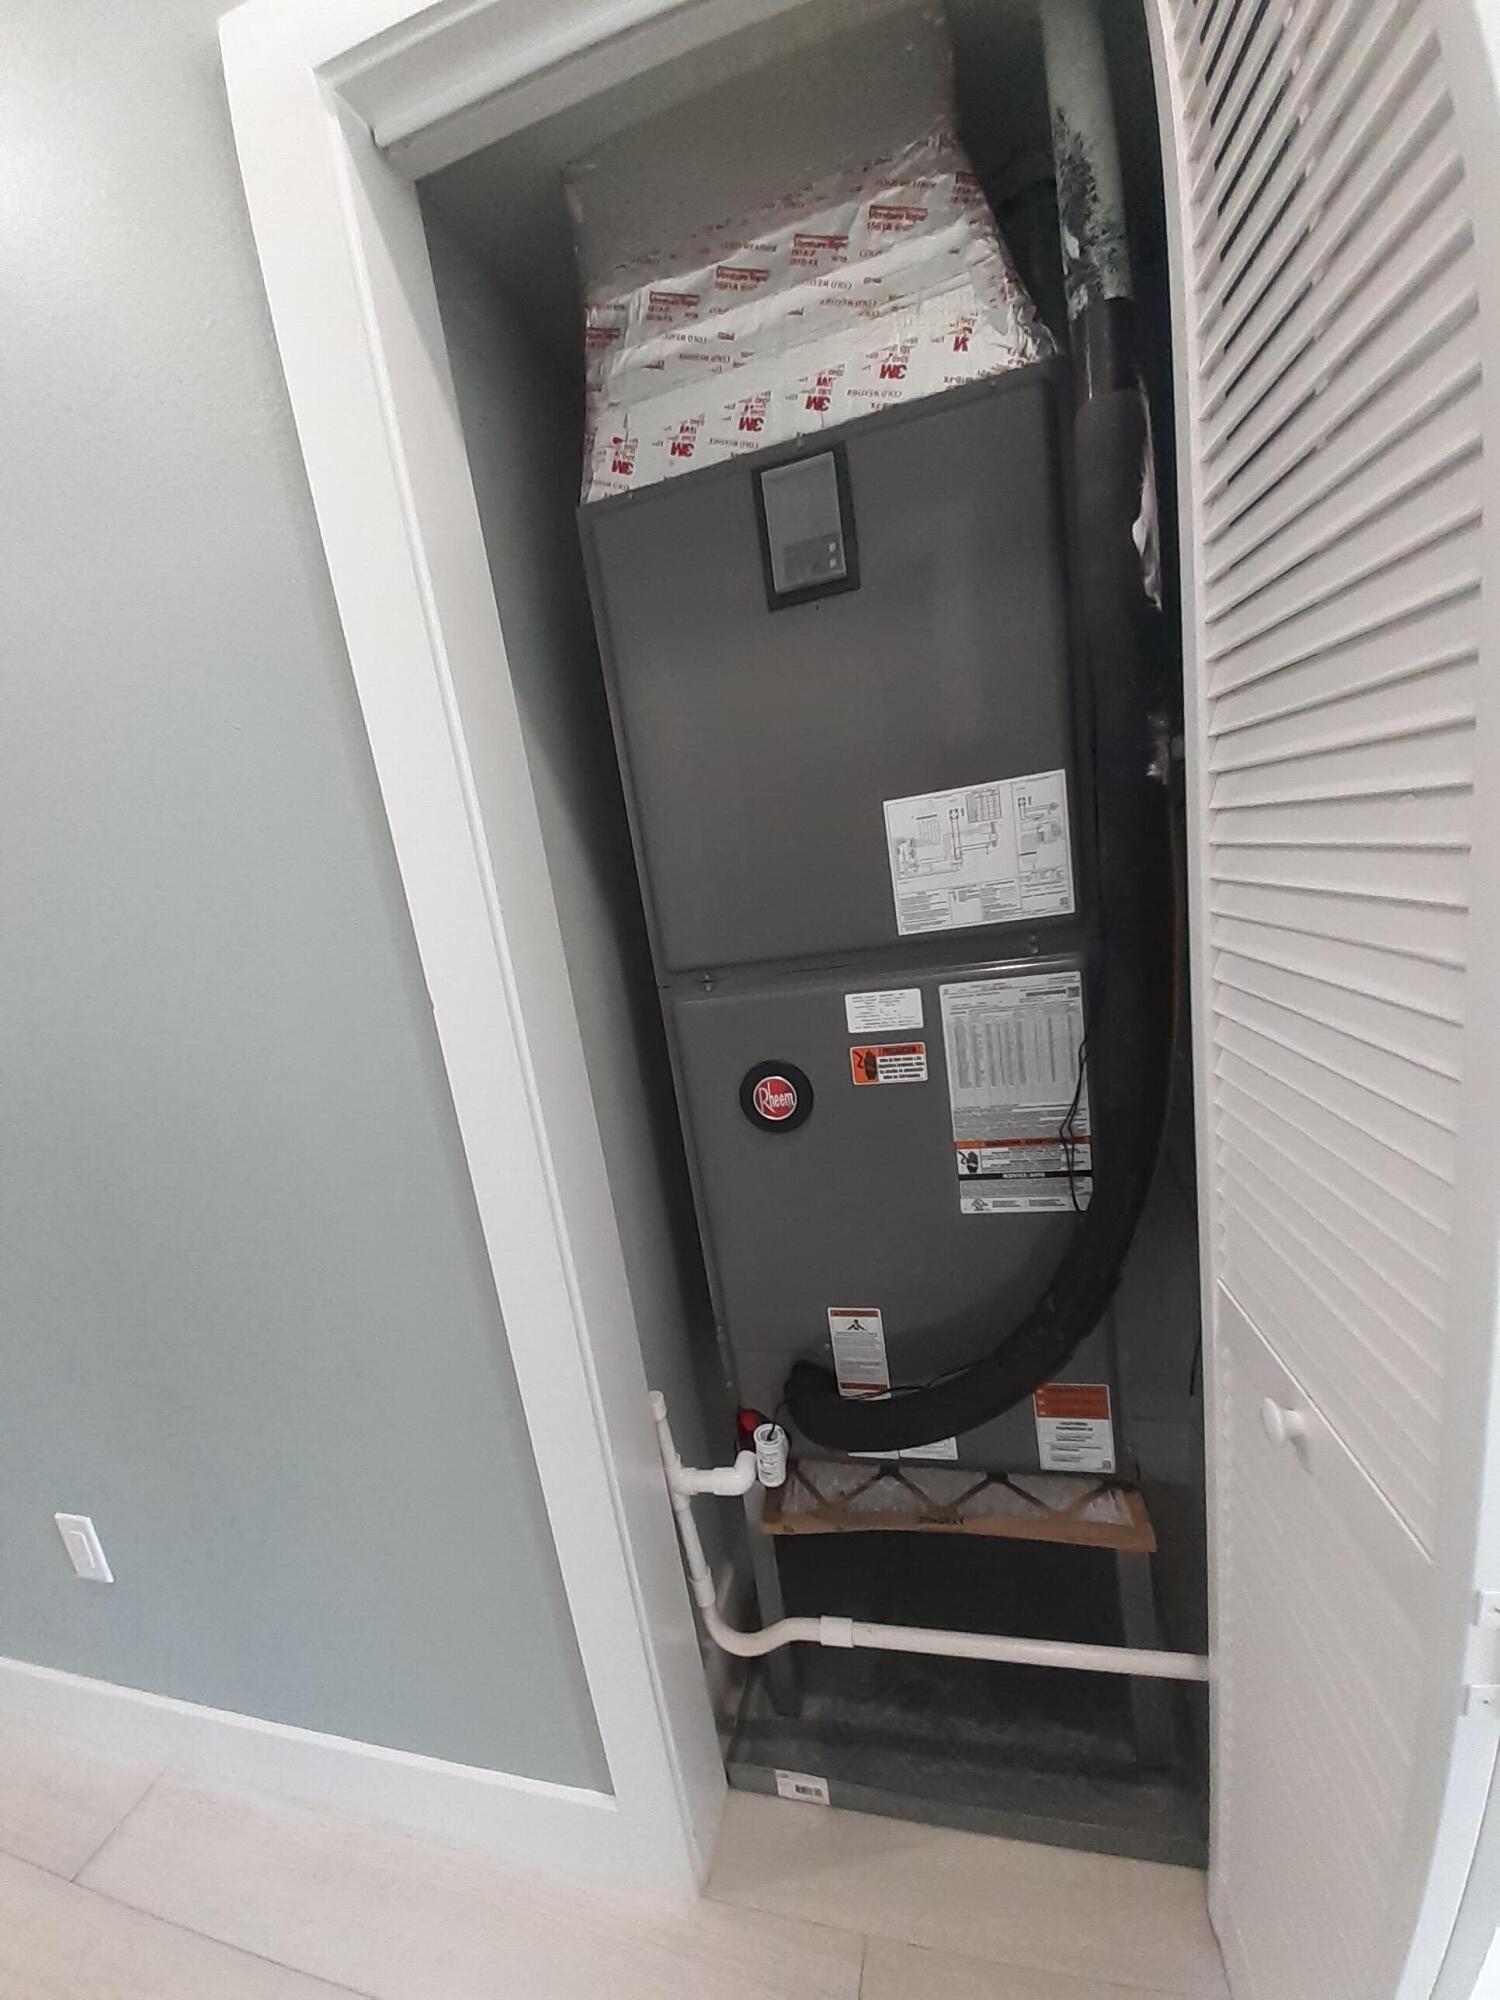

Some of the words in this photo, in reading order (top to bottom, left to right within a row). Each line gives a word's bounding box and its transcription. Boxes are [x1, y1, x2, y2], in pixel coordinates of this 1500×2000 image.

[878, 363, 908, 380] 3M
[805, 395, 832, 412] 3M
[738, 416, 764, 432] 3M
[670, 441, 695, 458] 3M
[611, 459, 635, 476] 3M
[758, 1081, 795, 1113] Rheem
